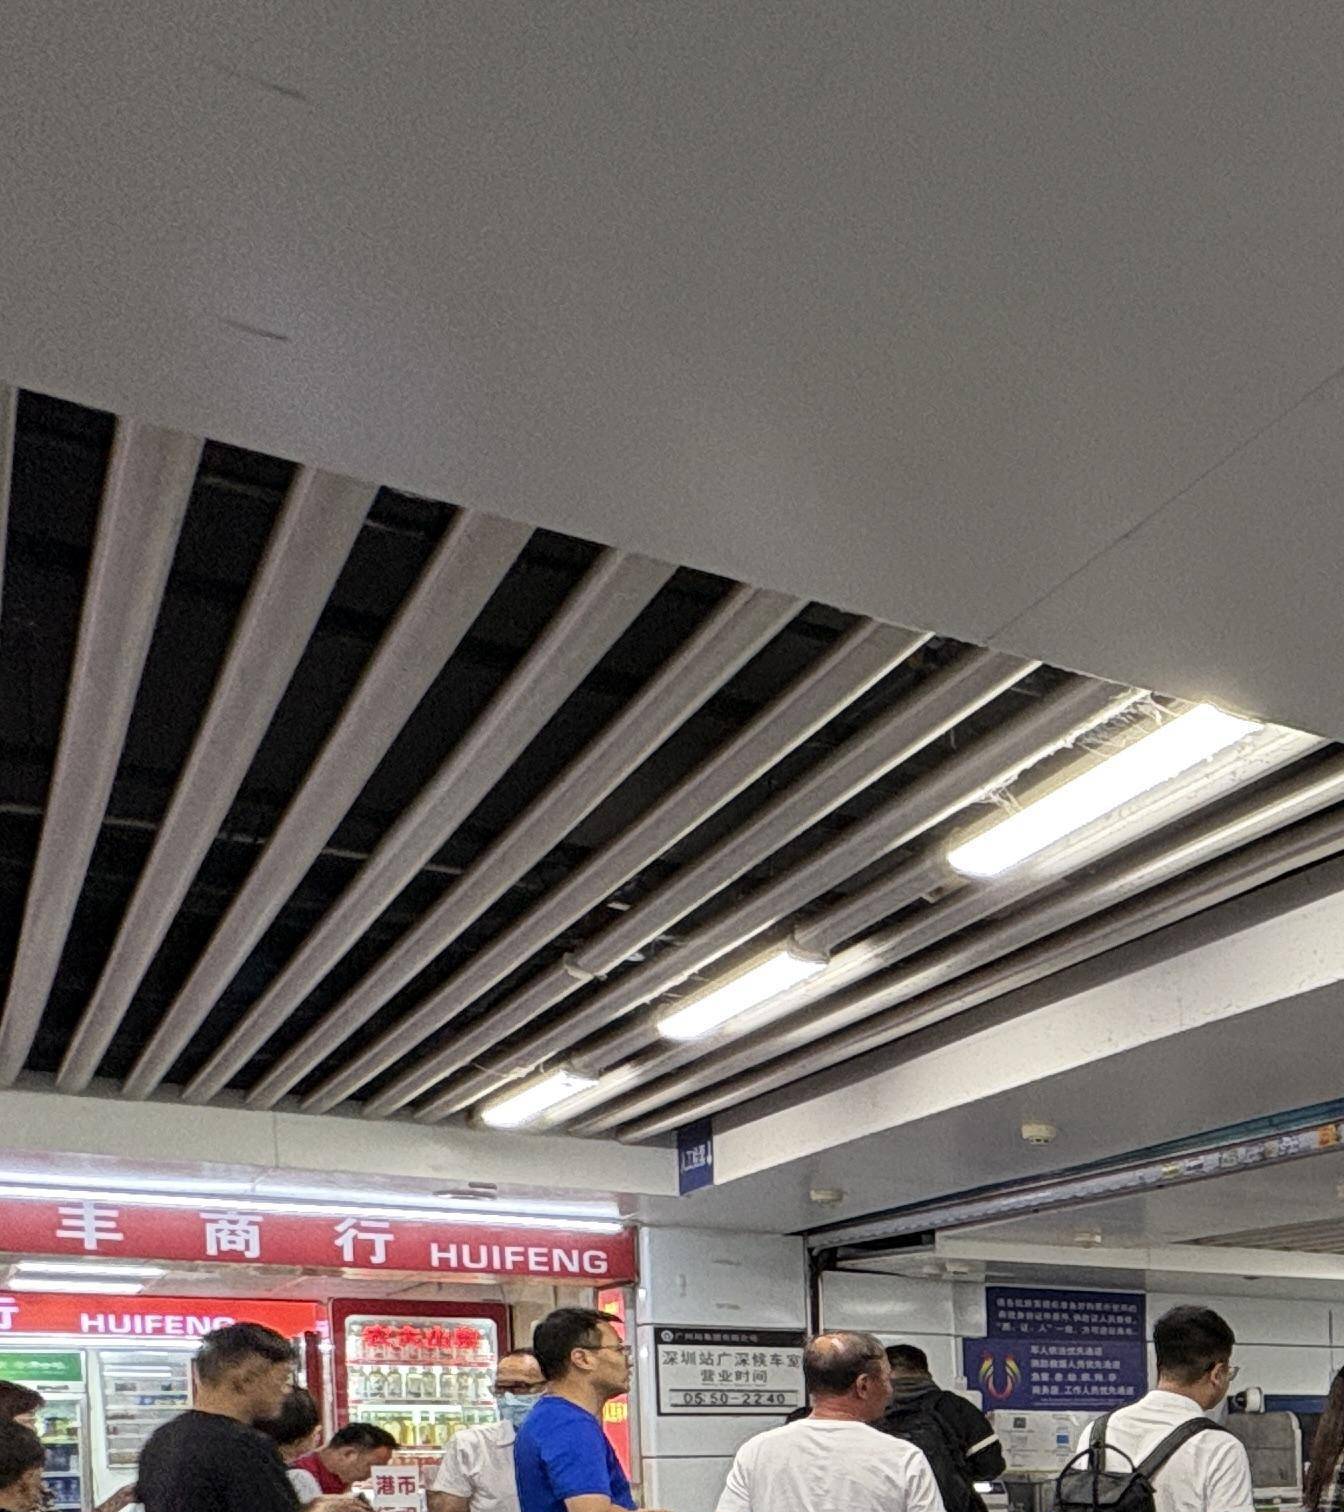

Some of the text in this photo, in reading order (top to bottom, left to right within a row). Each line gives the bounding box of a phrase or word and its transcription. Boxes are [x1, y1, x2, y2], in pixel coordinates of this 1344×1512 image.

[430, 1243, 609, 1274] HUIFENG
[701, 1369, 768, 1383] 营业时间
